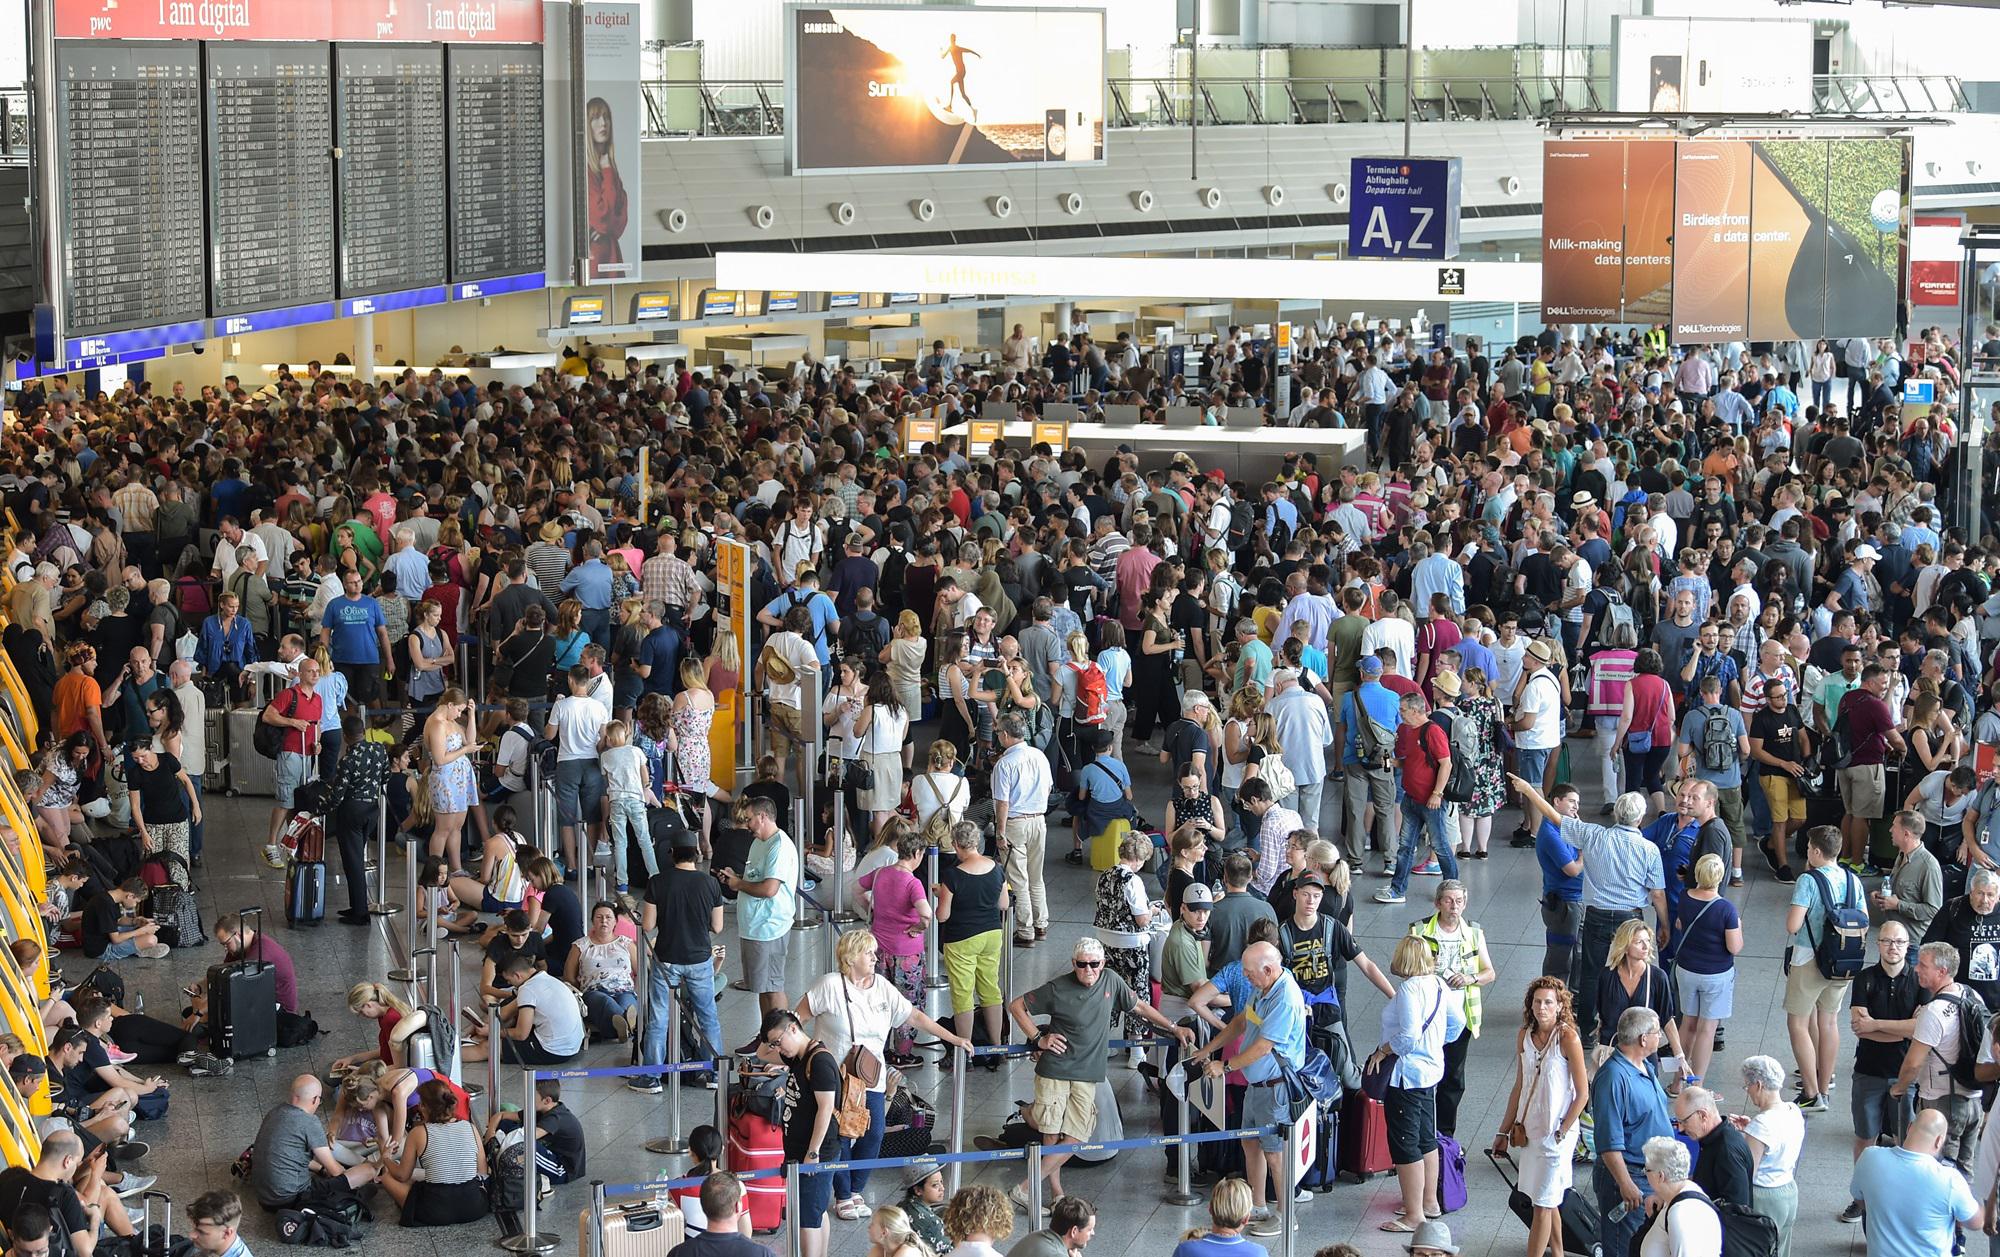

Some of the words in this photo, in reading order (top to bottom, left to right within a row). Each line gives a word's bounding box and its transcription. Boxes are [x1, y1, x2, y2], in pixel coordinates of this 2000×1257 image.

[159, 0, 165, 25] I
[169, 1, 195, 26] am
[199, 0, 250, 35] digital
[427, 5, 433, 30] I
[434, 12, 455, 30] am
[457, 3, 496, 38] digital
[594, 12, 630, 28] digital
[90, 16, 112, 35] pwc
[376, 20, 394, 38] pwc
[804, 23, 844, 33] SAMSUNG
[1366, 165, 1398, 174] Terminal
[1365, 176, 1409, 186] Abflughalle
[1365, 186, 1406, 196] Departures
[1407, 187, 1422, 195] hall
[1682, 214, 1722, 226] Birdies
[1722, 214, 1748, 226] from
[1362, 206, 1434, 254] A,Z
[1714, 233, 1720, 242] a
[1723, 232, 1748, 242] data
[1754, 232, 1792, 242] center.
[1549, 238, 1622, 252] Milk-making
[1594, 255, 1622, 265] data
[1626, 255, 1671, 265] centers
[924, 265, 1039, 286] Lufthansa
[1194, 890, 1204, 899] Y
[642, 1182, 668, 1190] Lufthansa
